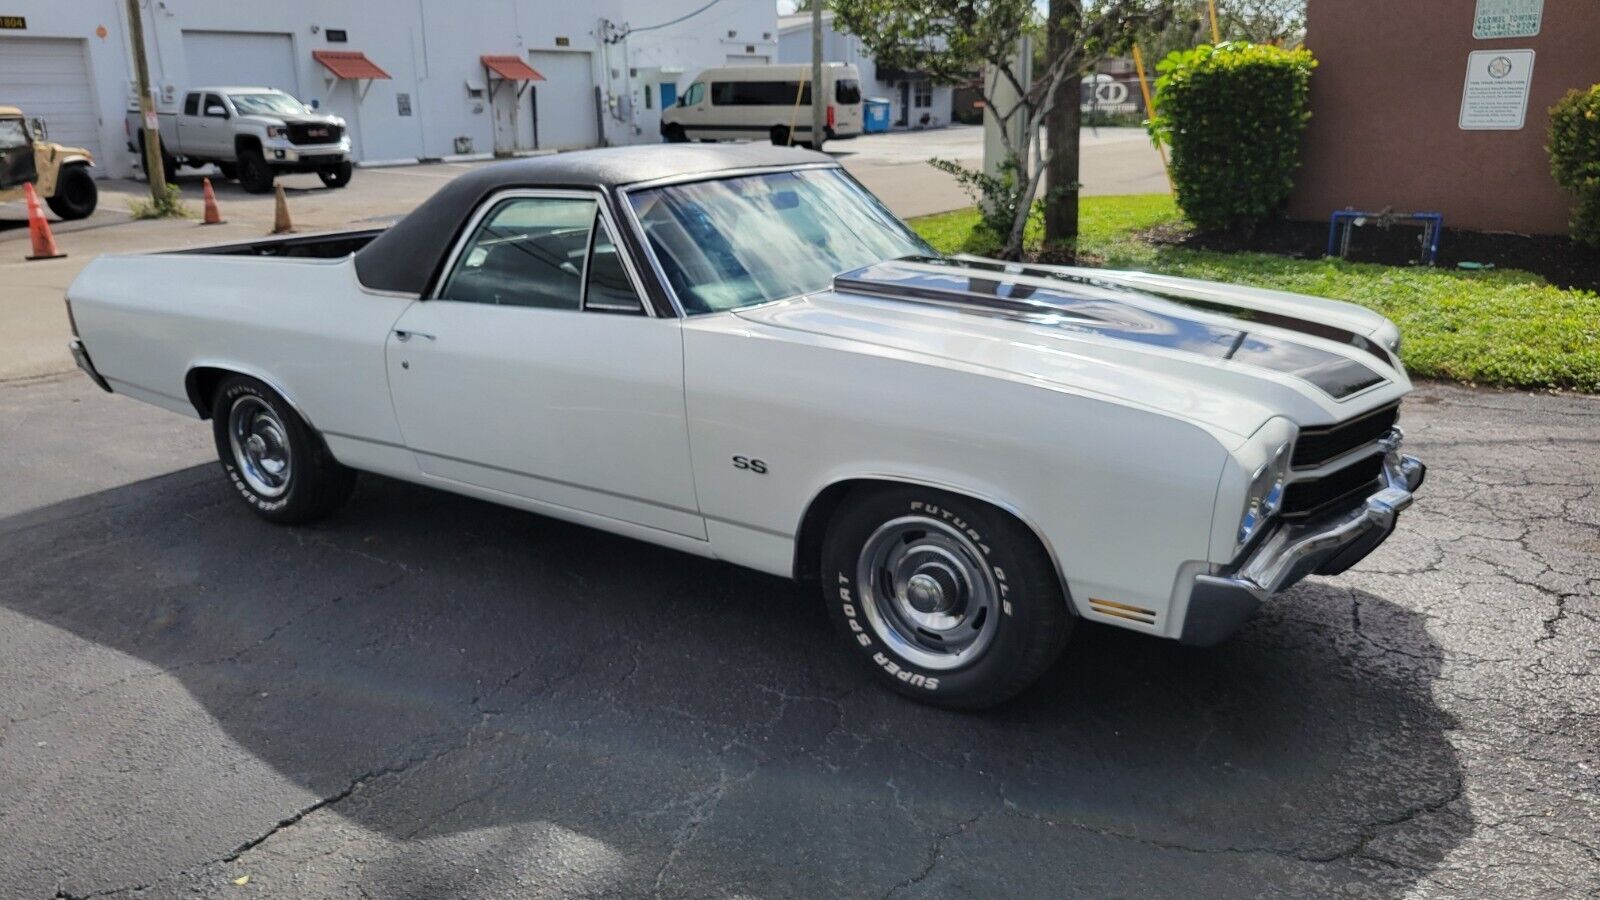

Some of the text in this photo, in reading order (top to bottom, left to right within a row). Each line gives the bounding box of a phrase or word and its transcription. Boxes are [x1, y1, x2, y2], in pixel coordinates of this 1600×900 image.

[1478, 14, 1537, 24] CARMEL TOWING
[732, 456, 768, 474] SS
[910, 501, 991, 555] FUTURA
[838, 571, 941, 691] SUPER SPORT
